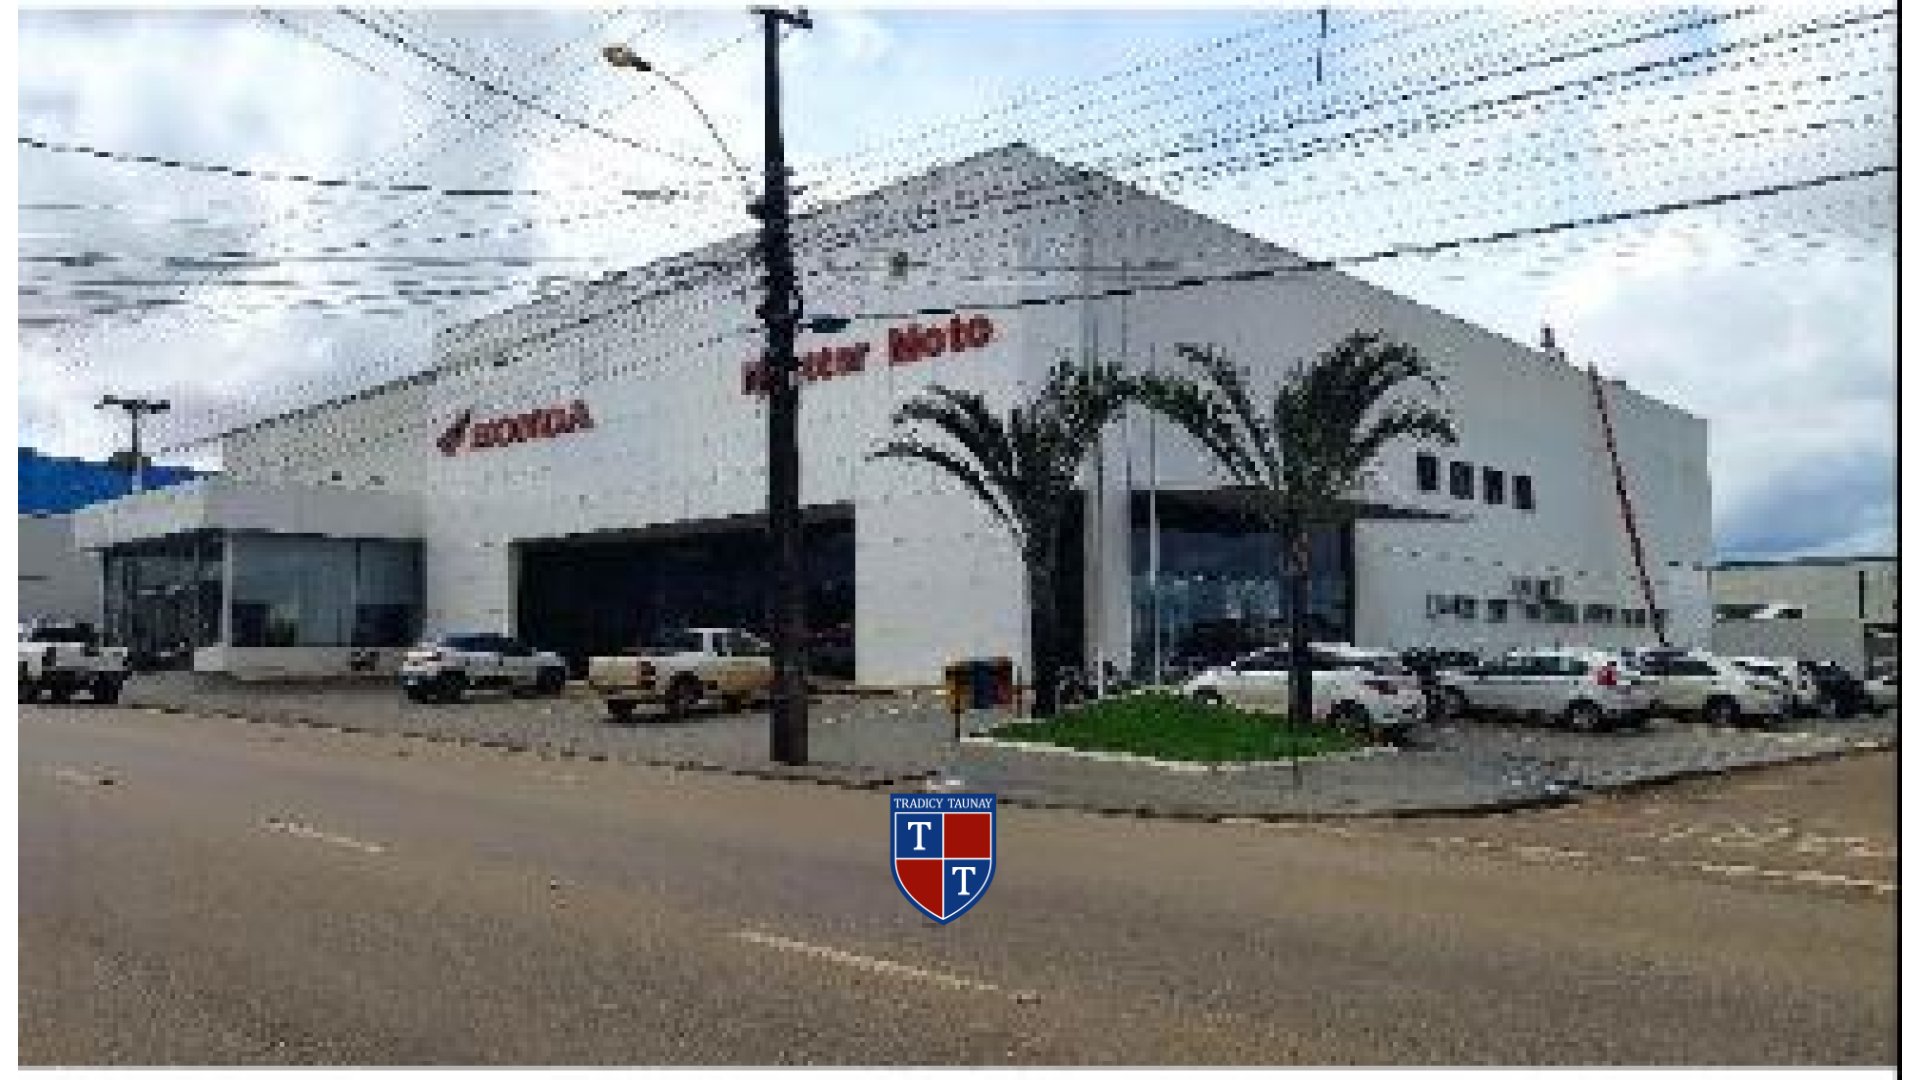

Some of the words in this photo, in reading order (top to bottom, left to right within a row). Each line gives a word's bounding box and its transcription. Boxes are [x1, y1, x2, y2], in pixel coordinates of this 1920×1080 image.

[741, 342, 870, 396] Mster
[888, 313, 993, 366] Moto
[470, 399, 594, 450] HONDA
